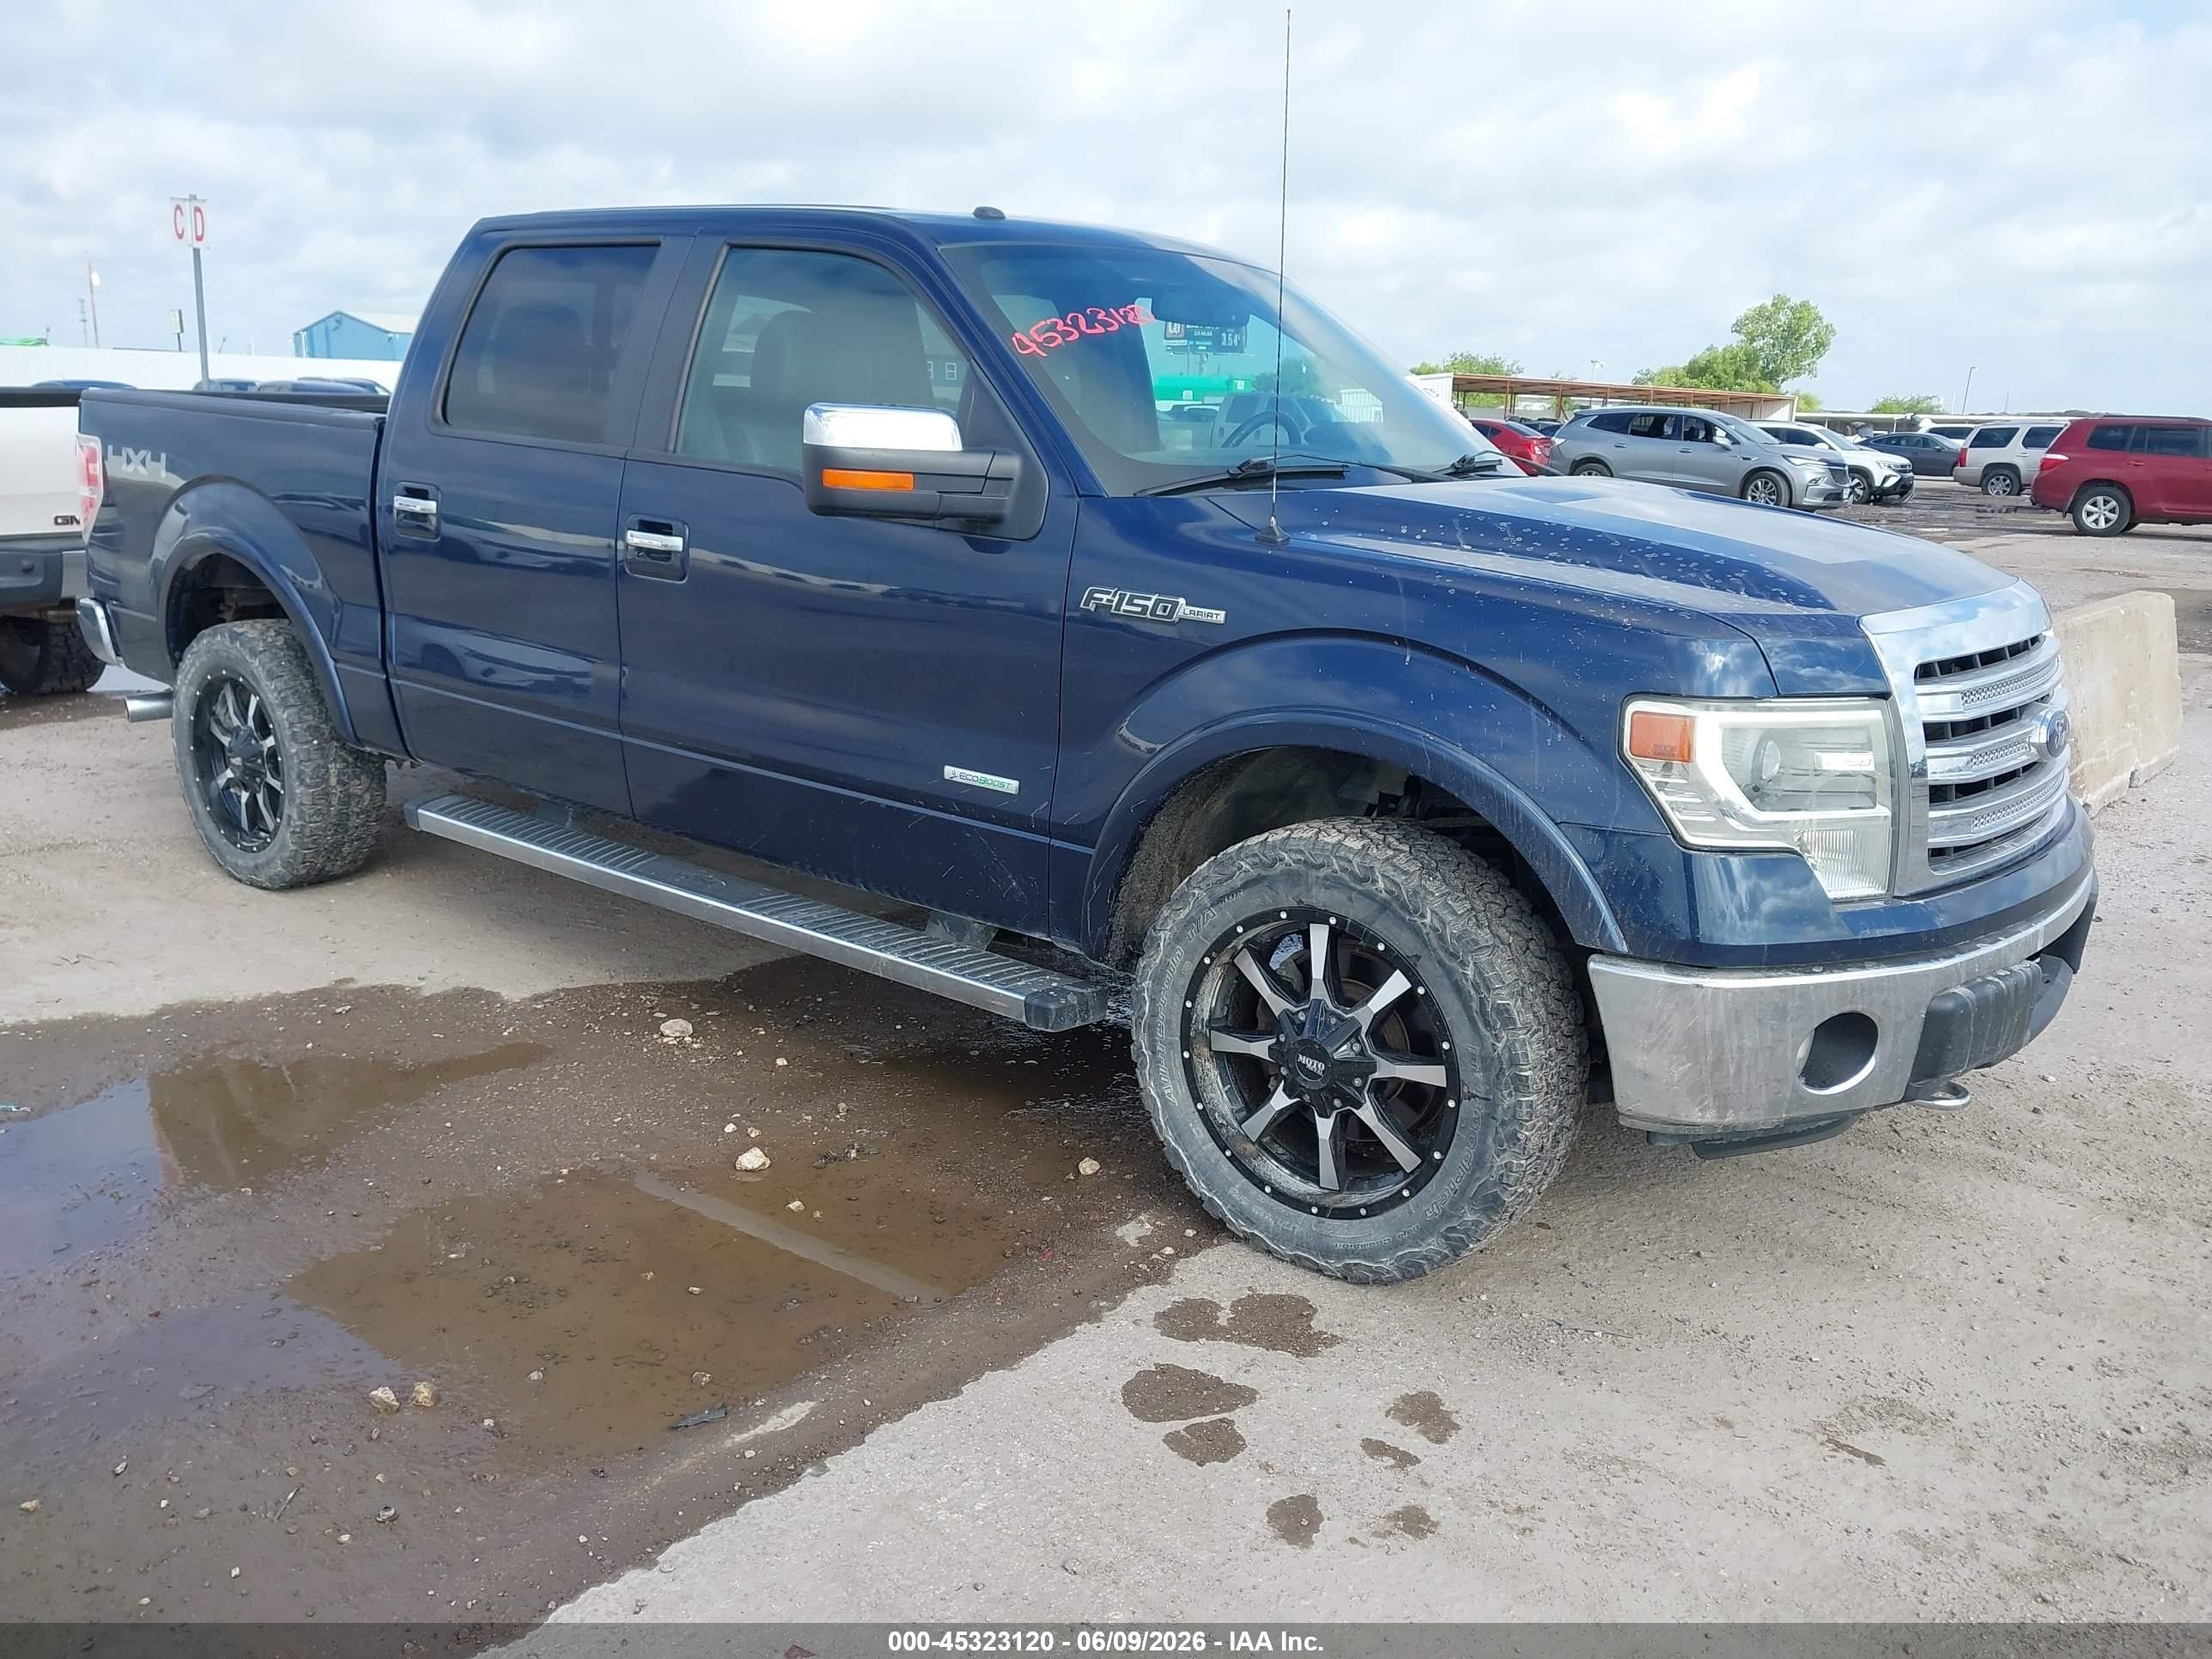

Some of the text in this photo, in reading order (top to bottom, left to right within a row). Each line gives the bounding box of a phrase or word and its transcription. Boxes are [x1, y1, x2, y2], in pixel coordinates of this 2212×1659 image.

[173, 204, 185, 240] C
[193, 205, 204, 241] D
[54, 515, 81, 525] GM
[1182, 608, 1221, 621] LARIAT
[1297, 1053, 1326, 1072] MOTO
